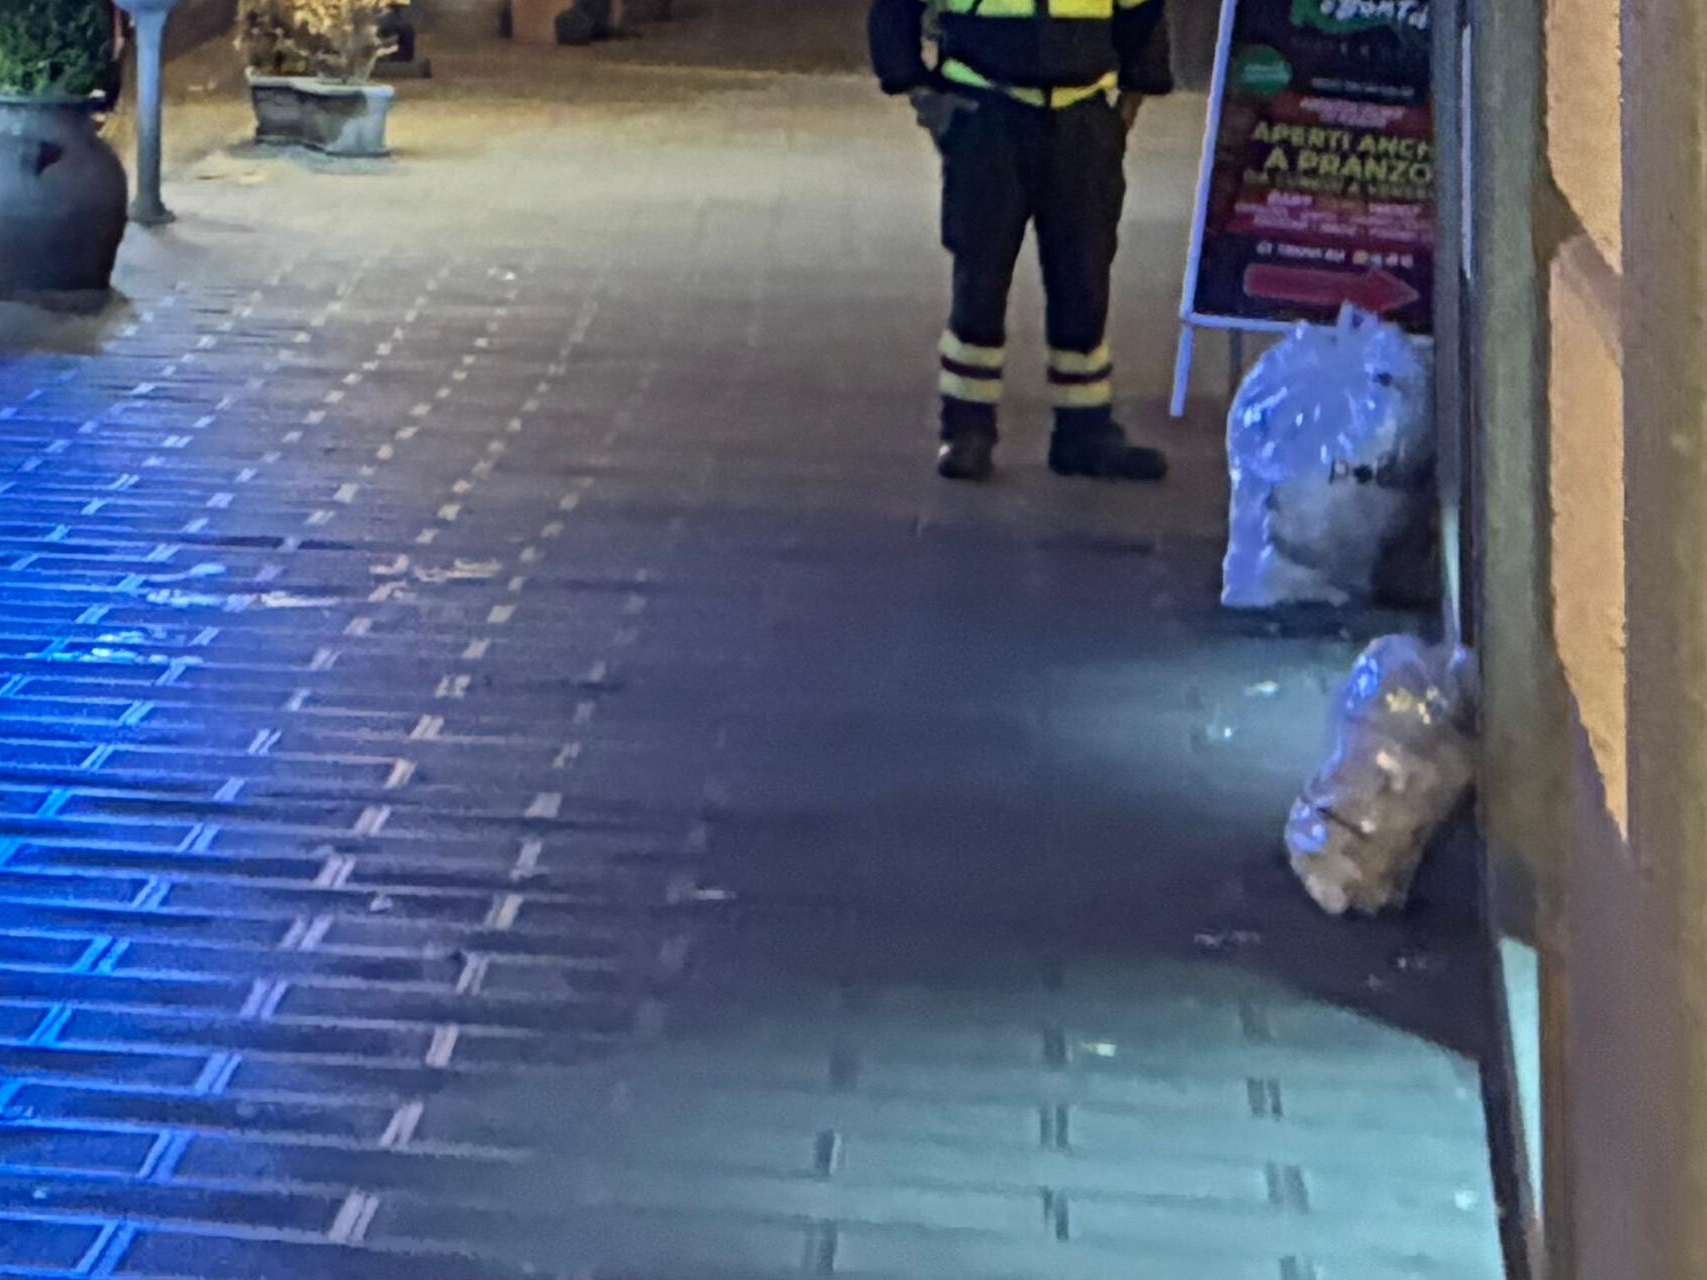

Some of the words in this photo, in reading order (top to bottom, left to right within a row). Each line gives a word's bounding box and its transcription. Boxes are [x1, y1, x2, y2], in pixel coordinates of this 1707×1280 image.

[1253, 121, 1351, 151] APERTI
[1264, 146, 1289, 172] A
[1297, 149, 1432, 184] PRANZO
